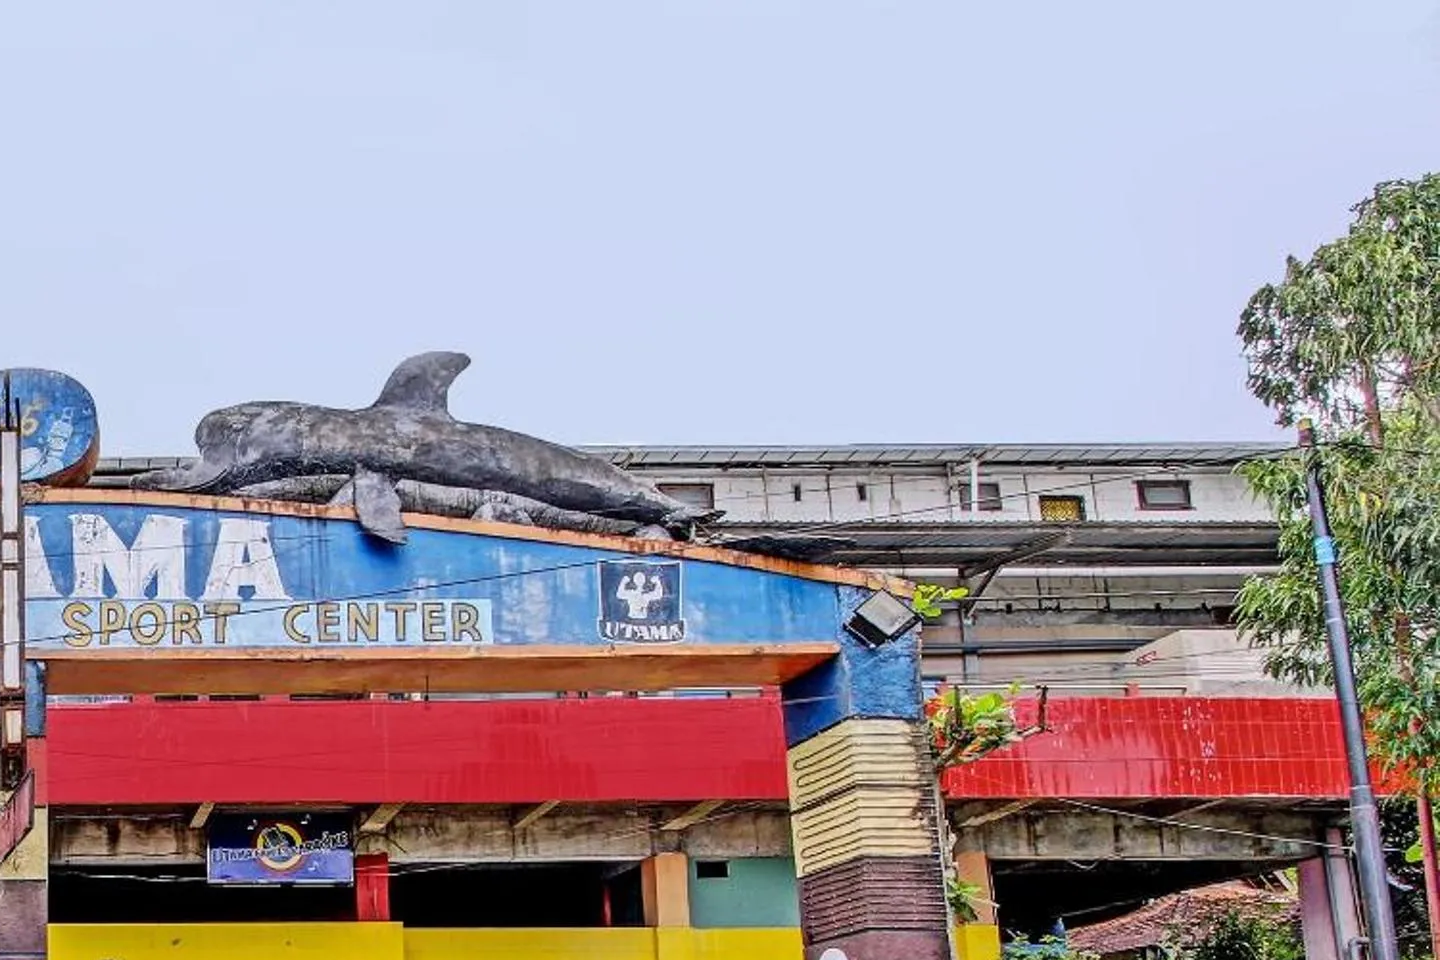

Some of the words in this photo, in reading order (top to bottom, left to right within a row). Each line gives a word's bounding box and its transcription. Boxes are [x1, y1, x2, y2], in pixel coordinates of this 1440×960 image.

[62, 601, 241, 648] SPORT
[284, 601, 483, 644] CENTER
[605, 621, 682, 641] UTAMA
